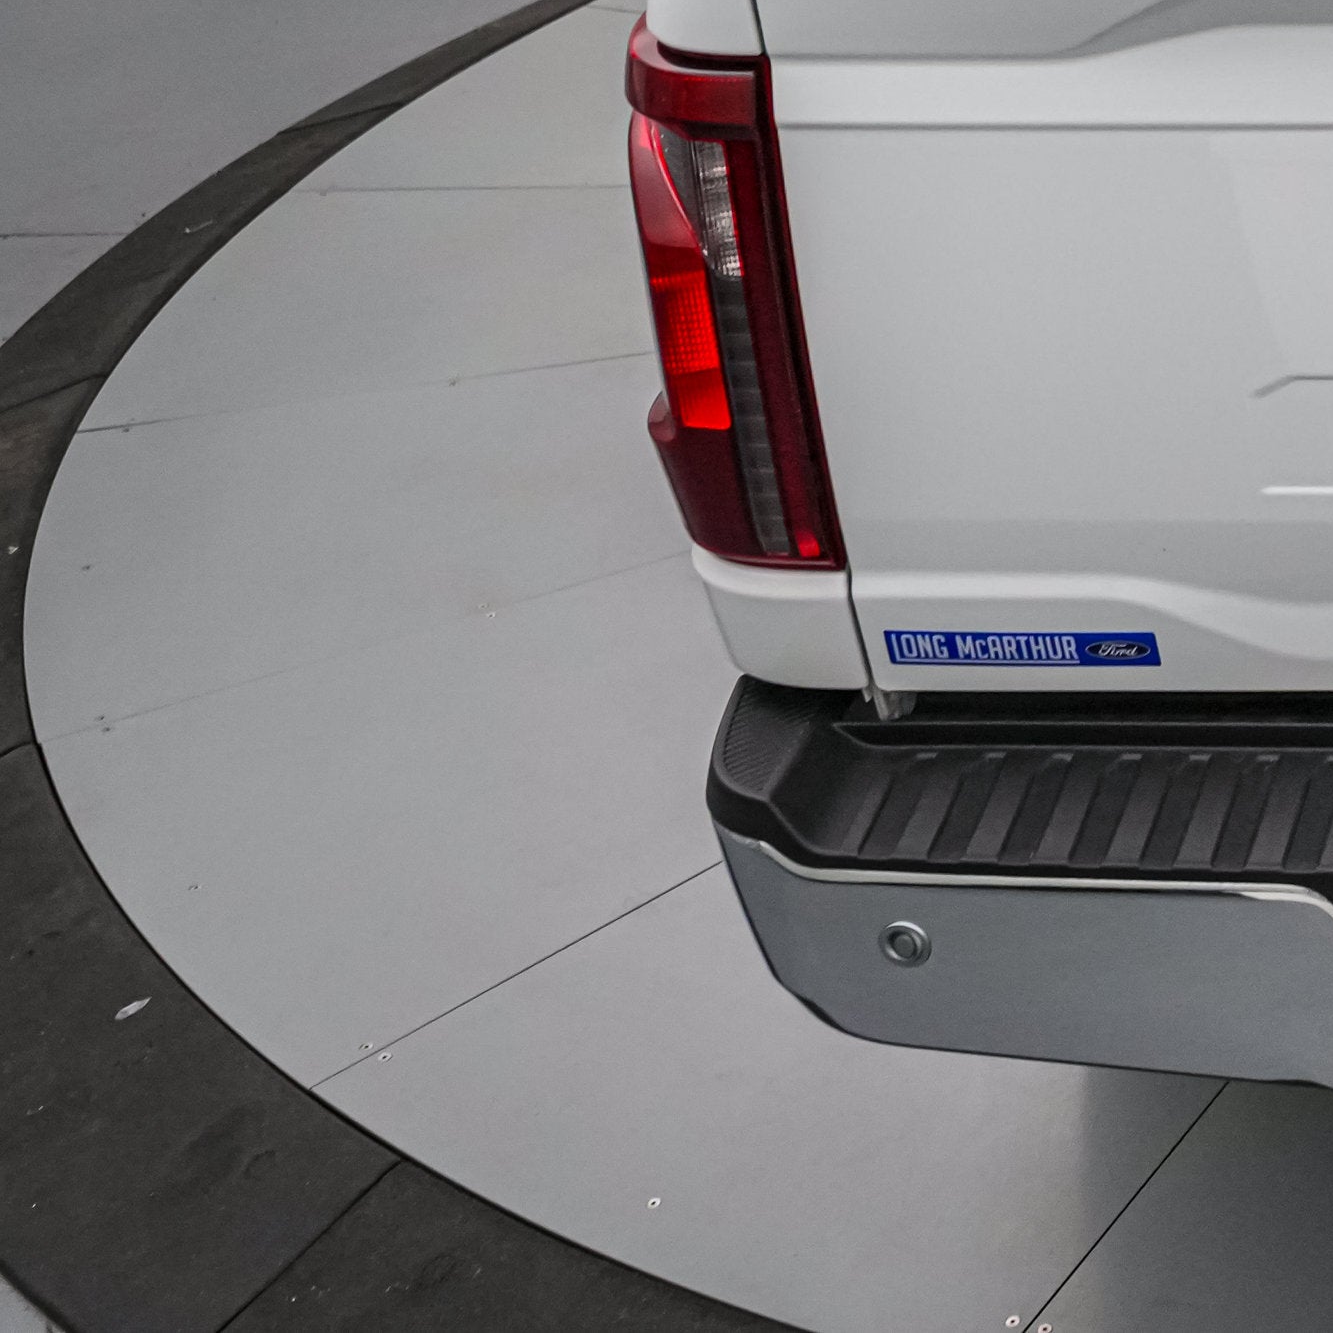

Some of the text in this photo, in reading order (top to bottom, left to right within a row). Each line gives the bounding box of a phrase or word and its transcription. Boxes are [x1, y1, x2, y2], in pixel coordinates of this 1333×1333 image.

[890, 632, 1139, 661] LONG McARTHUR Ford
